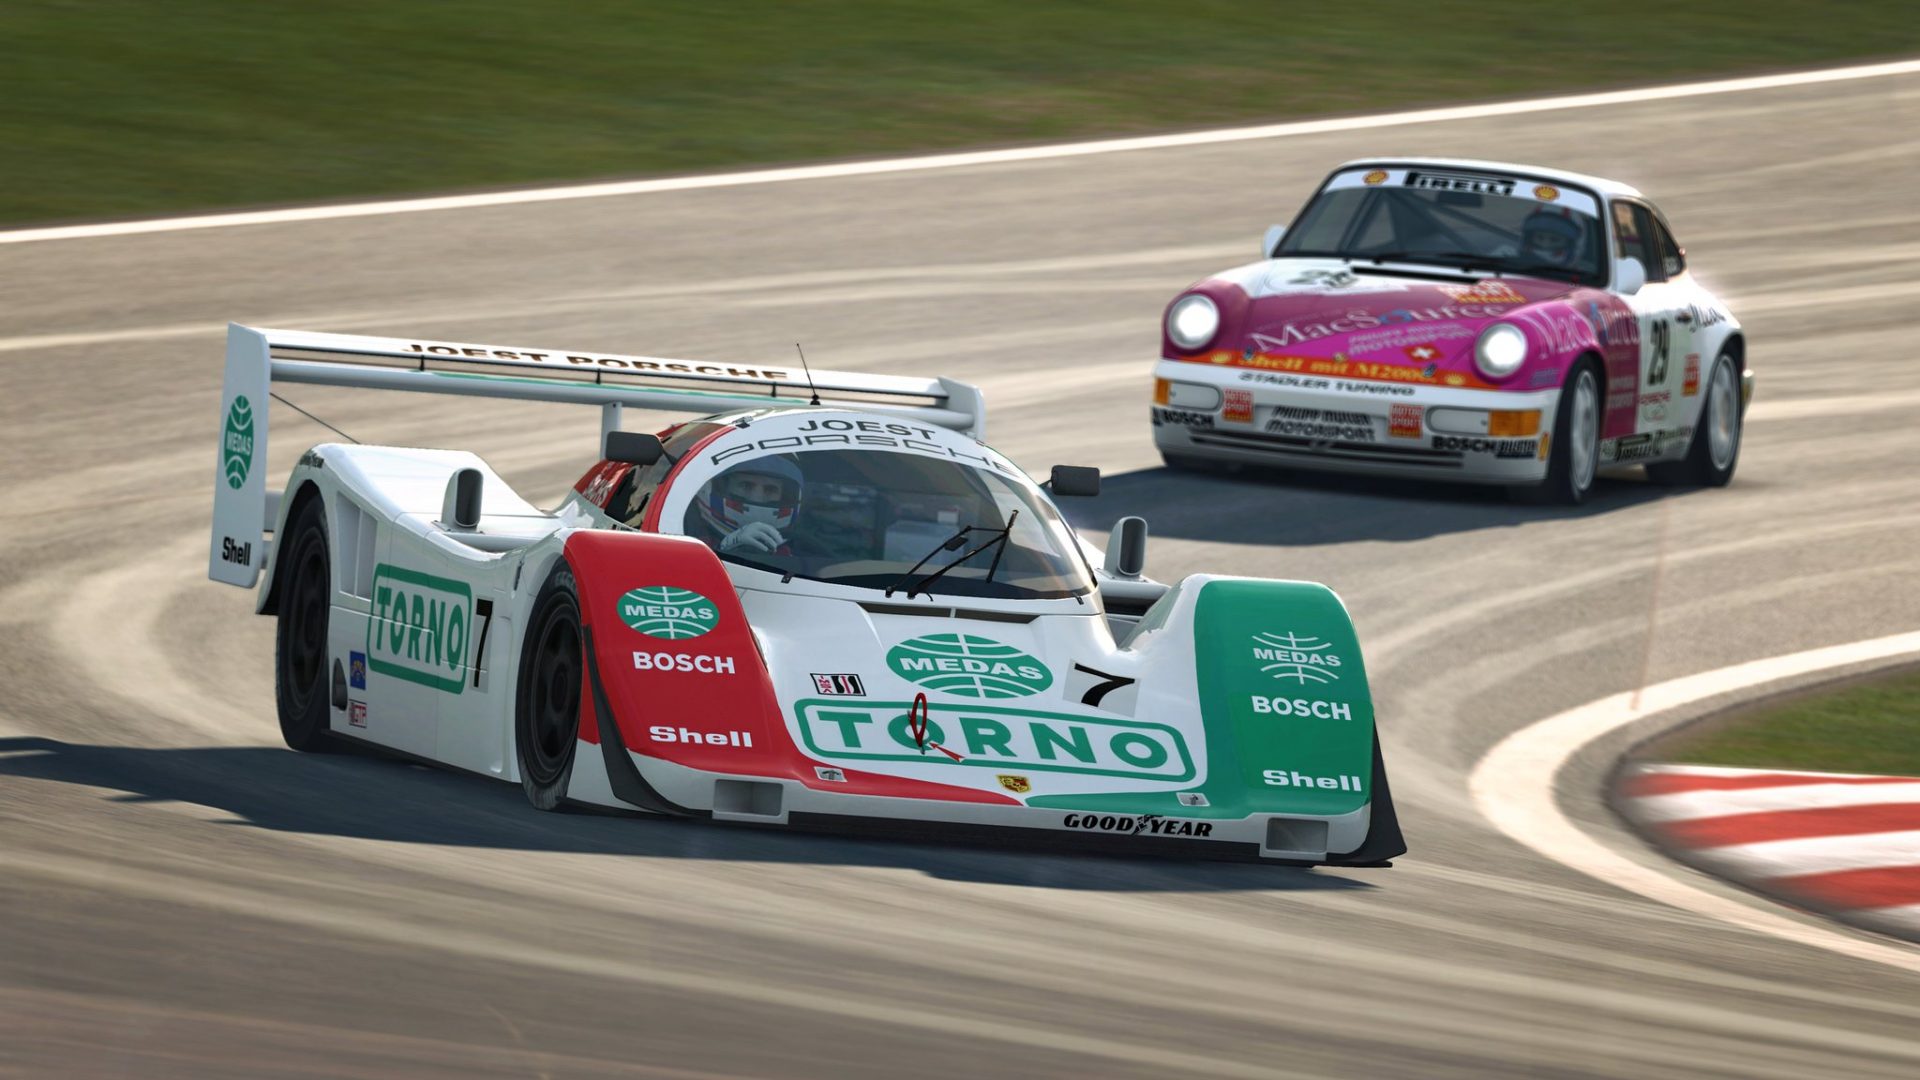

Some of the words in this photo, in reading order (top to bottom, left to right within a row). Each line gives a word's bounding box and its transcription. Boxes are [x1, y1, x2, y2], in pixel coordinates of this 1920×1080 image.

[1403, 171, 1517, 196] PIRELLI
[1249, 305, 1505, 352] MacSource
[404, 343, 549, 362] JOEST
[566, 355, 788, 380] PORSCHE
[1239, 371, 1330, 389] STADLER
[1335, 380, 1415, 396] TUNING
[798, 419, 938, 440] JOEST
[1163, 408, 1214, 427] BOSCH
[1266, 419, 1375, 442] MOTORSPORT
[227, 431, 252, 455] MEDAS
[1432, 436, 1496, 453] BOSCH
[711, 434, 1020, 478] PORSCHE
[222, 536, 252, 567] Shell
[625, 604, 714, 620] MEDAS
[376, 586, 464, 671] TORNO
[473, 598, 493, 688] 7
[632, 651, 736, 674] BOSCH
[900, 657, 1044, 680] MEDAS
[1252, 647, 1342, 667] MEDAS
[1074, 662, 1136, 707] 7
[1251, 695, 1352, 721] BOSCH
[649, 725, 753, 748] Shell
[816, 710, 1168, 769] TORNO
[1262, 769, 1362, 792] Shell
